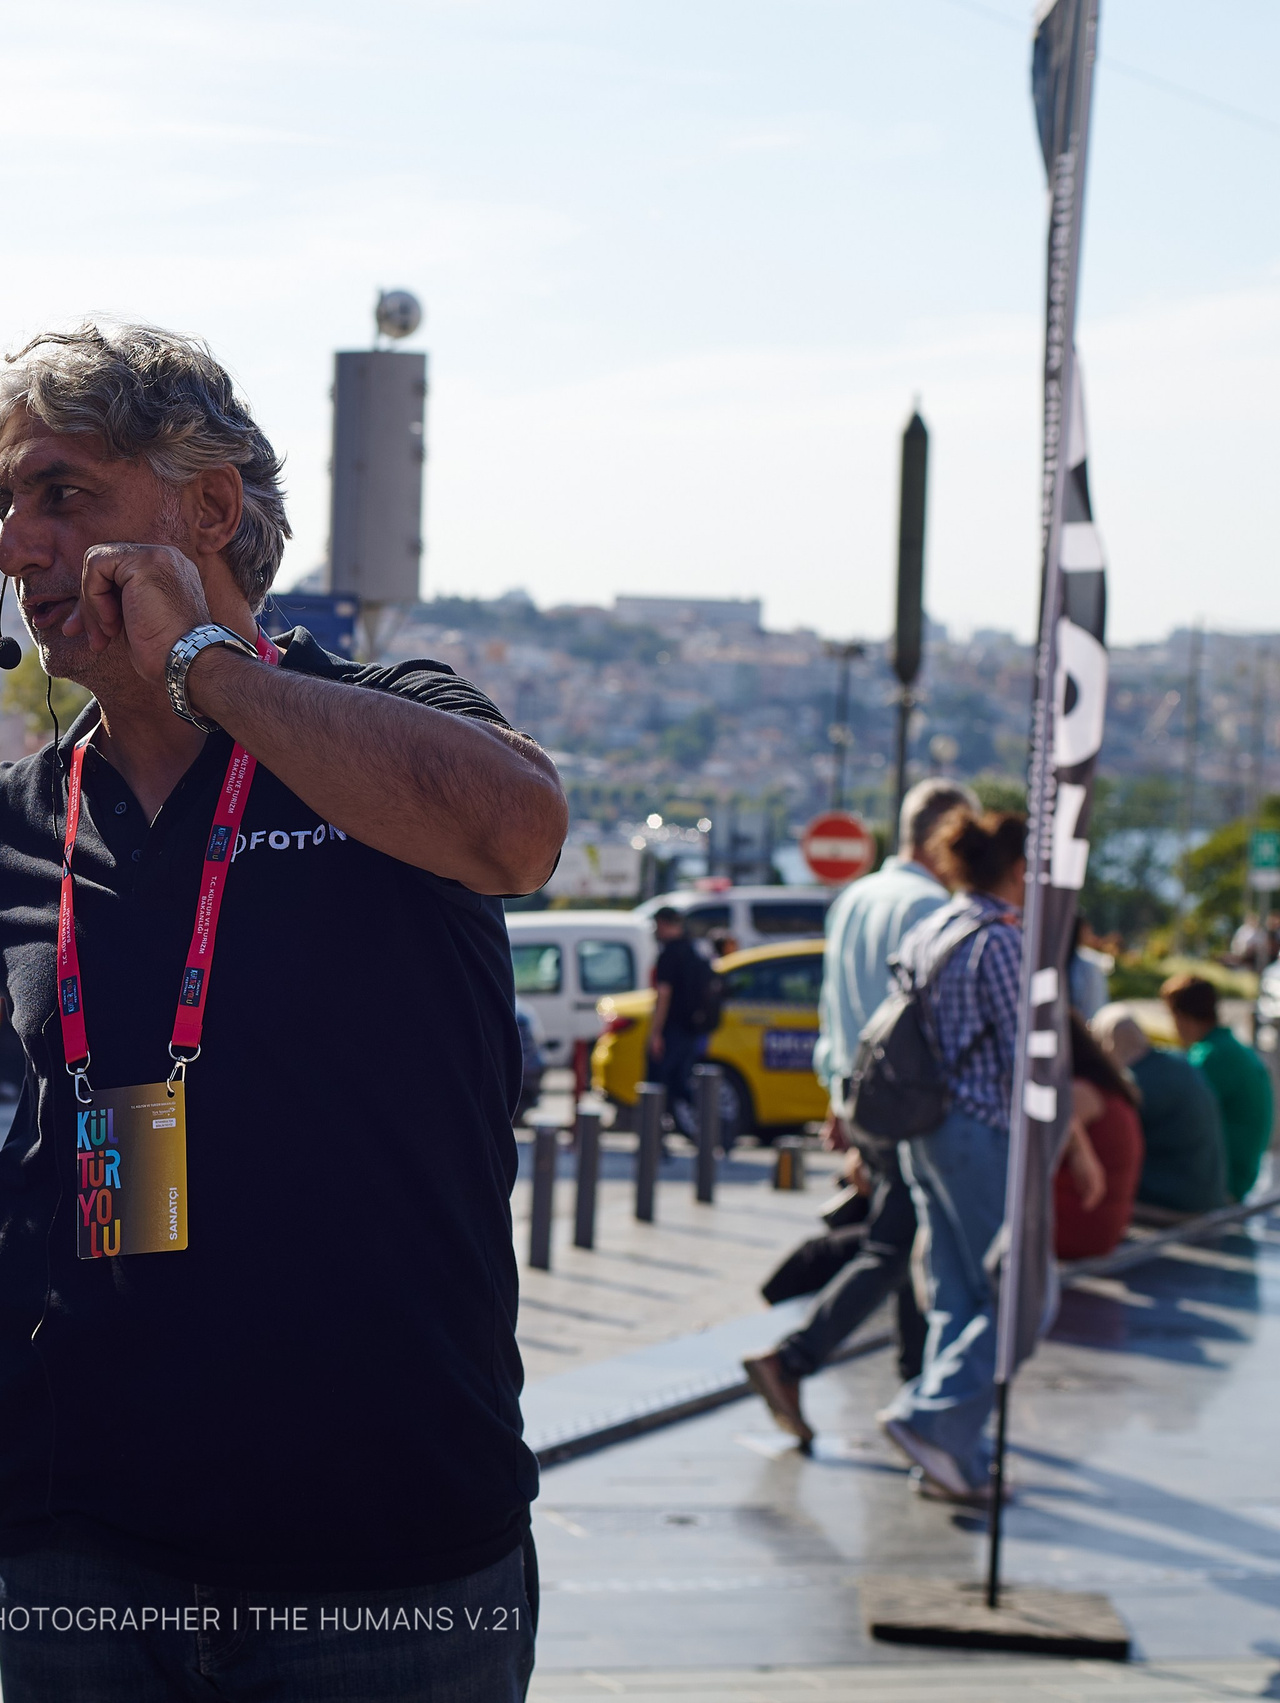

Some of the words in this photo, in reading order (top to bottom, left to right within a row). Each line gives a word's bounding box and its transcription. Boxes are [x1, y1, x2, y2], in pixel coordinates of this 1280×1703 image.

[77, 1108, 119, 1150] KÜL
[77, 1149, 122, 1189] TÜR
[78, 1188, 113, 1227] YO
[169, 1187, 179, 1240] SANATÇI
[90, 1219, 121, 1257] LU
